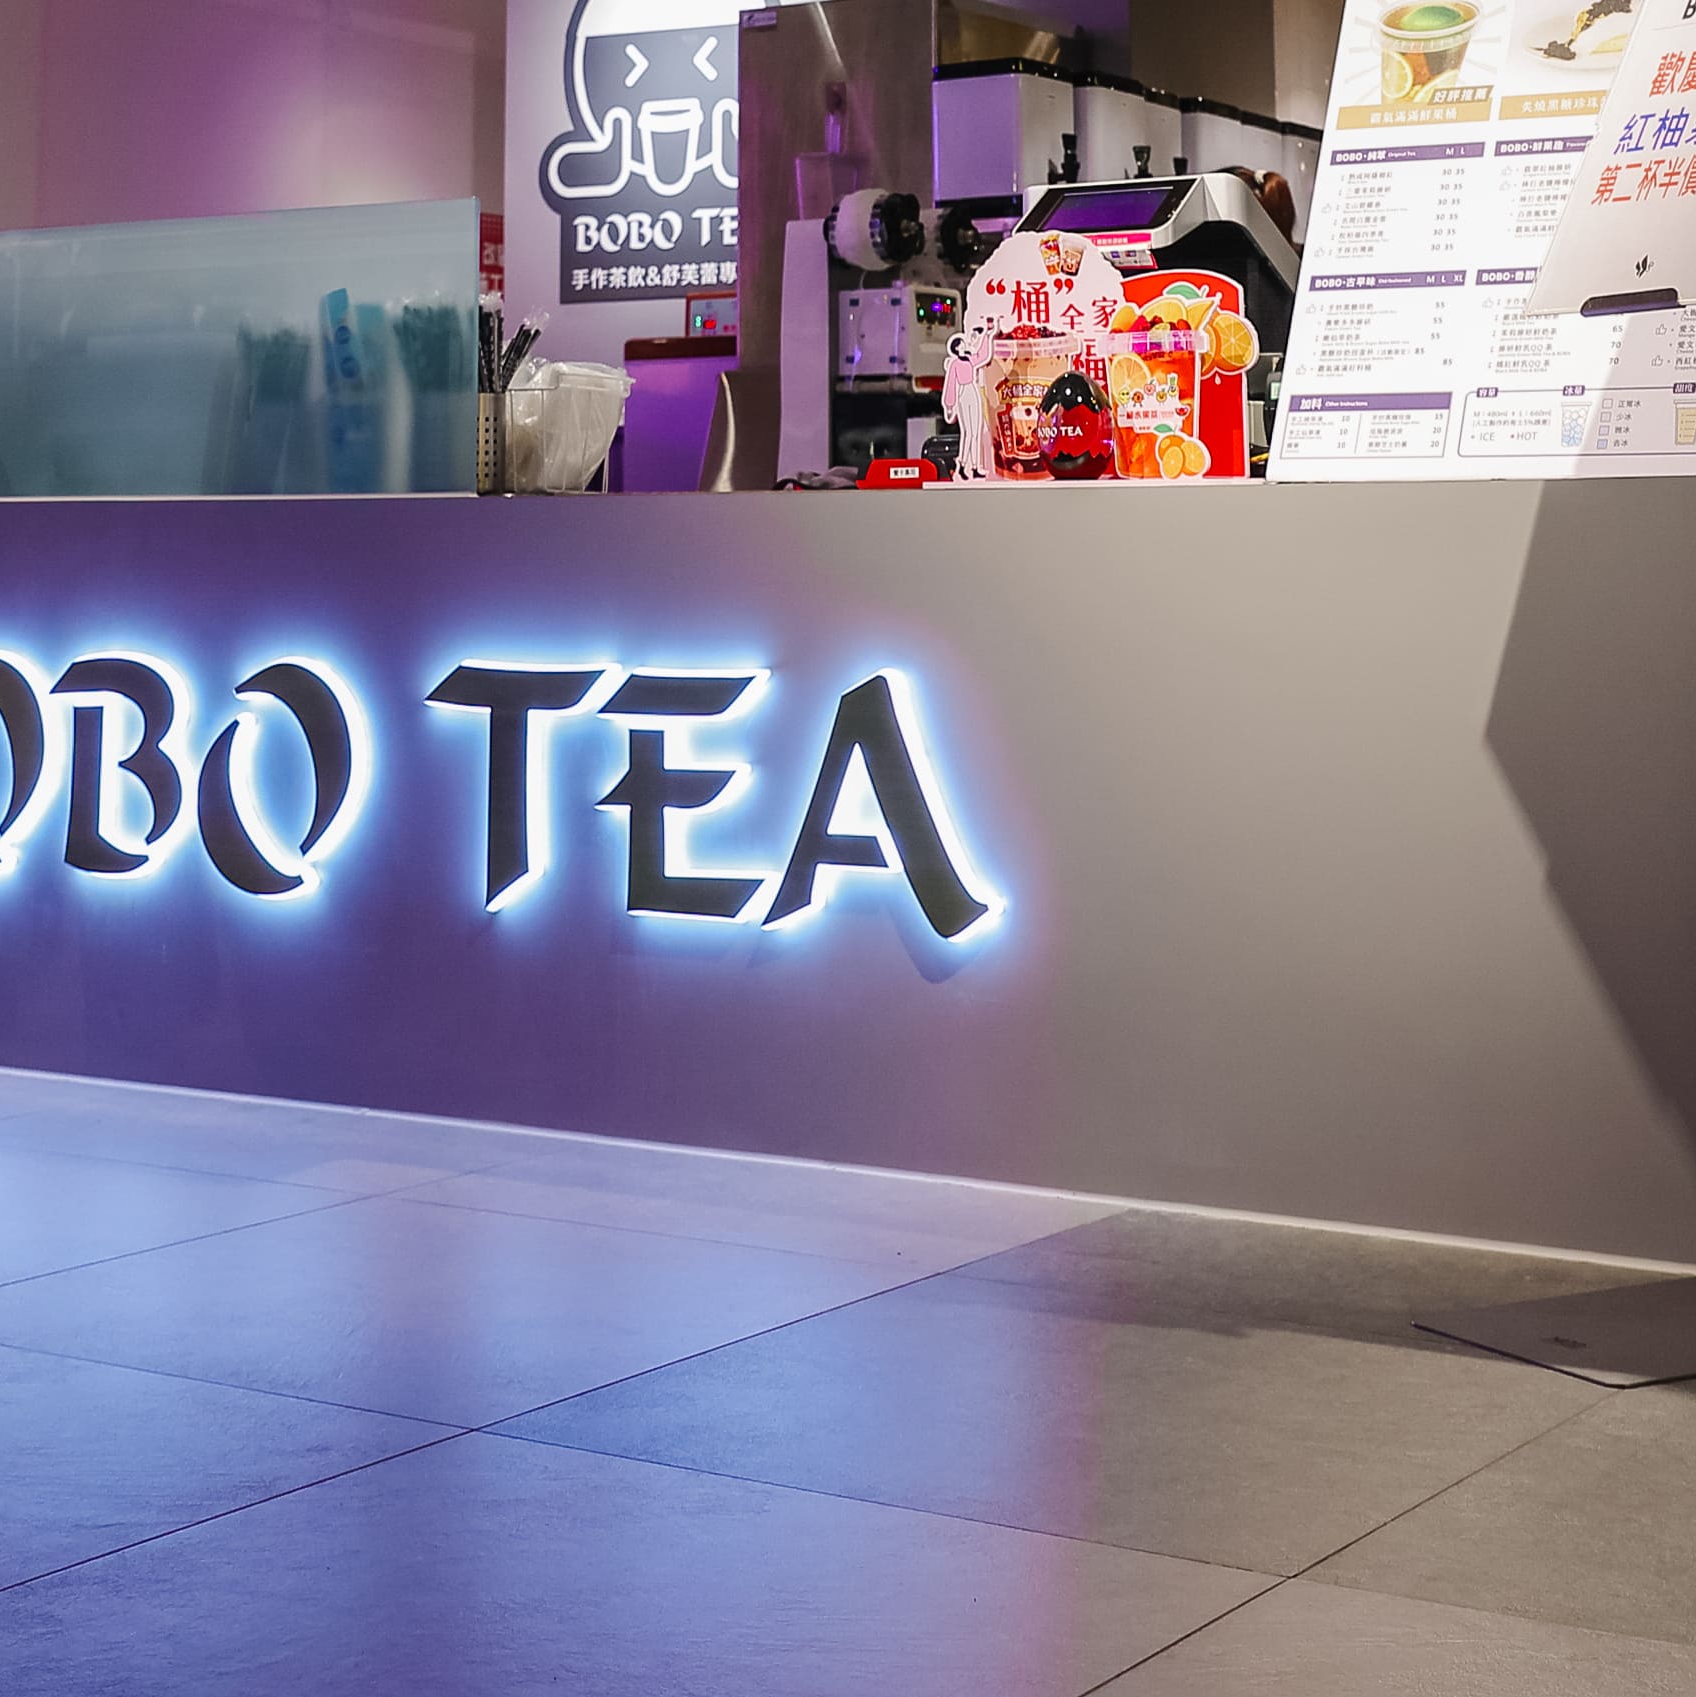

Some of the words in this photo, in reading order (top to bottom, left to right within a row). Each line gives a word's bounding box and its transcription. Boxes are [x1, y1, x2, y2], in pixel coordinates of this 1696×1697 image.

[573, 210, 683, 252] BOBO
[691, 207, 738, 247] TE
[1426, 276, 1435, 284] M
[1441, 275, 1446, 283] L
[1454, 274, 1463, 282] XL
[1613, 325, 1623, 333] 65
[1611, 341, 1621, 349] 70
[1609, 357, 1619, 365] 70
[1617, 400, 1642, 408] 正常冰
[1059, 426, 1083, 437] TEA
[1433, 426, 1442, 434] 20
[1479, 432, 1495, 441] ICE
[1517, 431, 1537, 440] HOT
[1430, 440, 1440, 448] 20
[425, 659, 1005, 942] TEA
